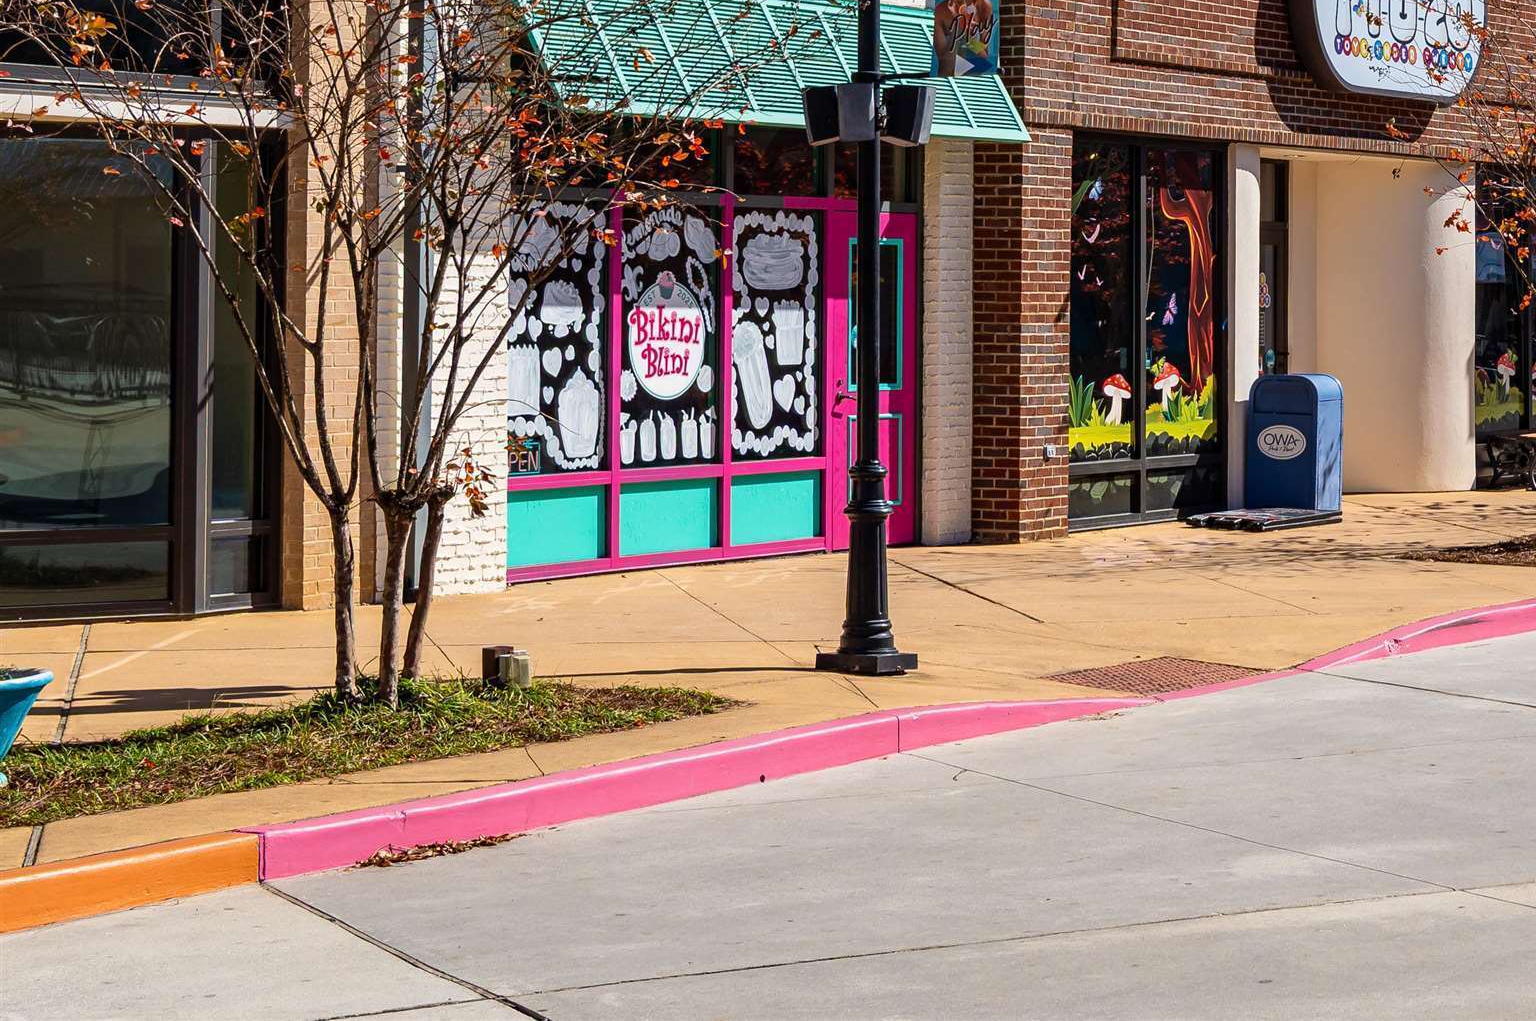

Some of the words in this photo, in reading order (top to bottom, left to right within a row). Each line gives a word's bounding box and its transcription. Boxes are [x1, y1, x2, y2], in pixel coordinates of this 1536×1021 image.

[949, 12, 998, 52] Play
[629, 304, 702, 346] Bikini
[641, 344, 690, 379] Blini
[1264, 433, 1301, 446] OWA
[509, 450, 539, 472] PEN
